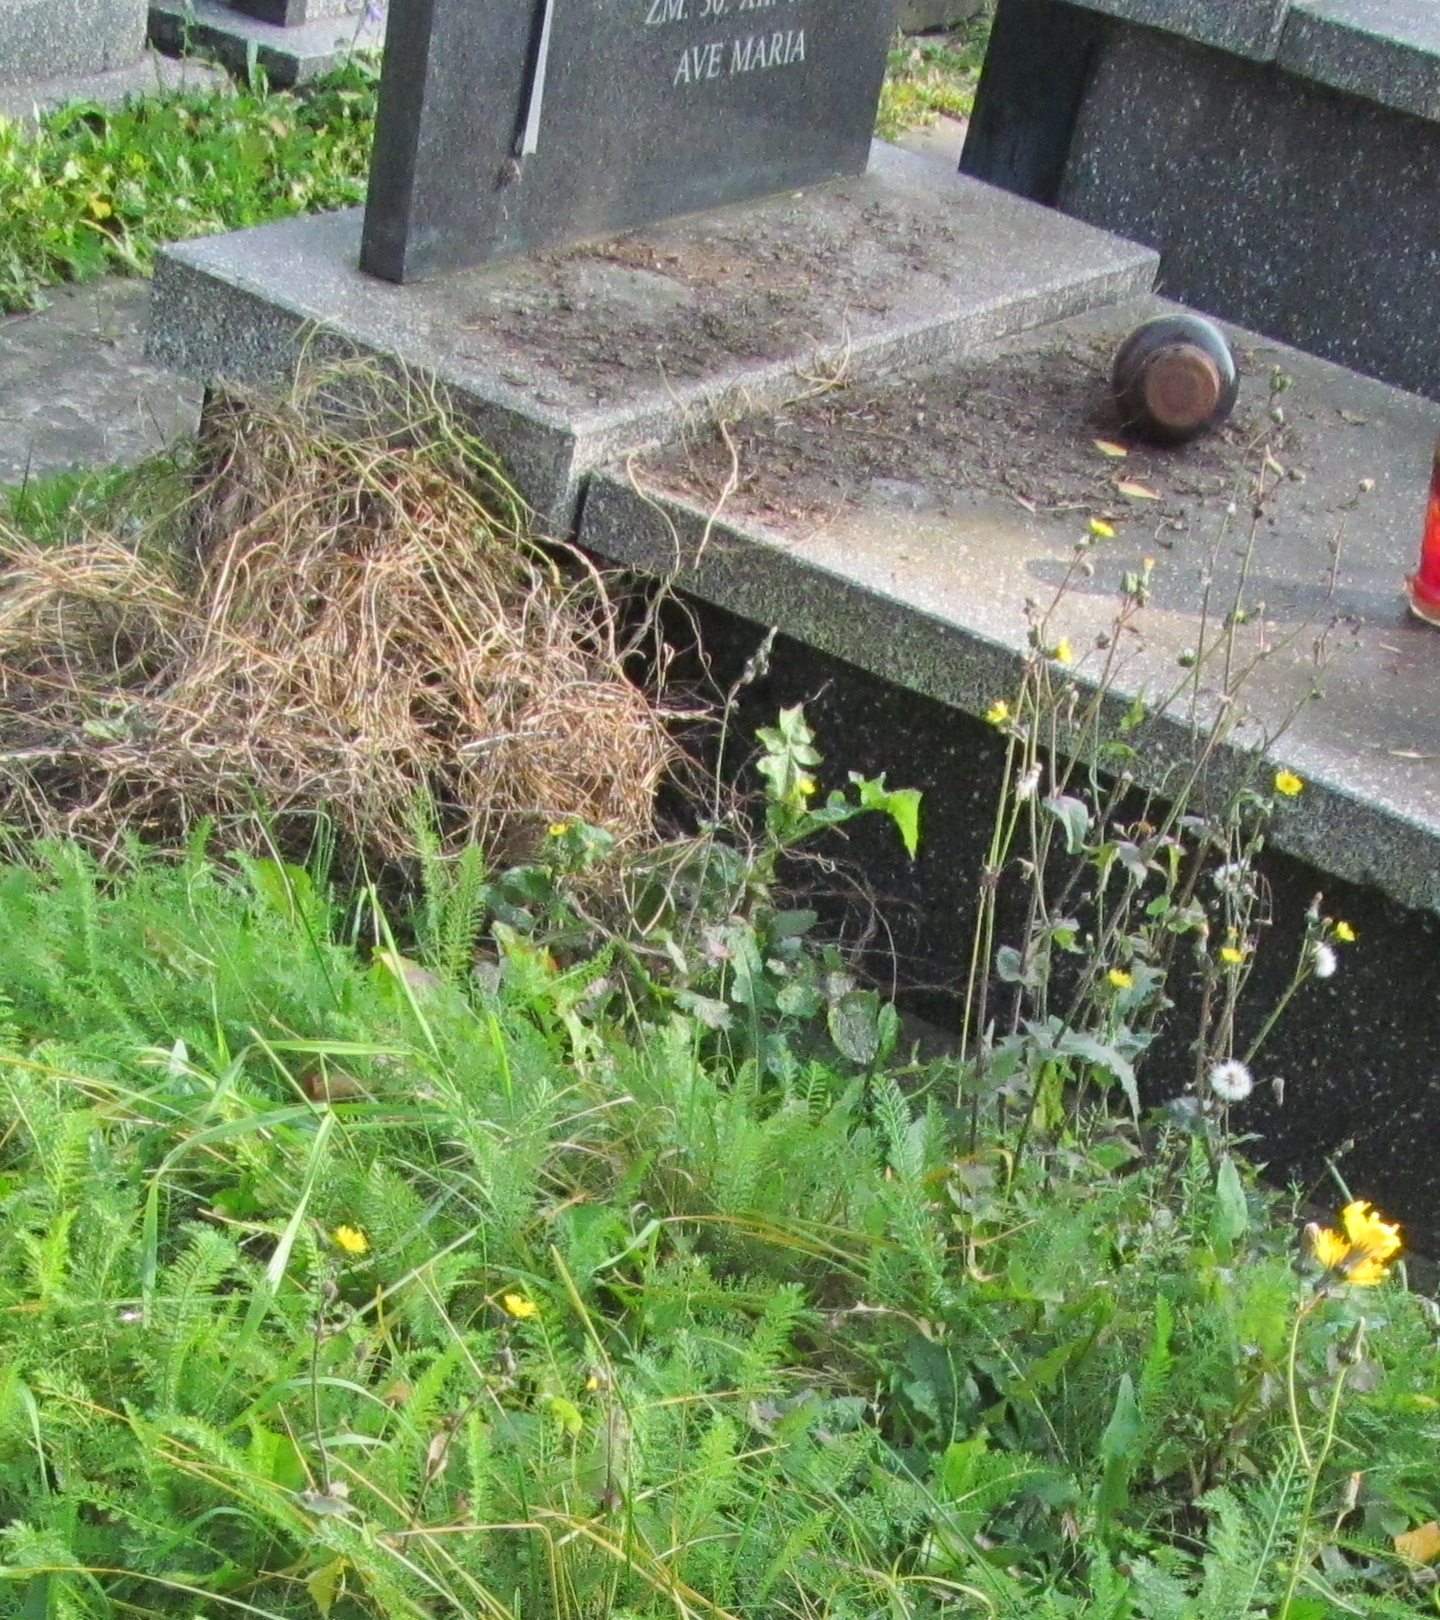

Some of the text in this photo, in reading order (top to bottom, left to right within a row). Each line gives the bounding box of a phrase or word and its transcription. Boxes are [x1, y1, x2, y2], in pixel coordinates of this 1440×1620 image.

[645, 0, 689, 25] ZM.
[673, 28, 806, 87] AVE MARIA
